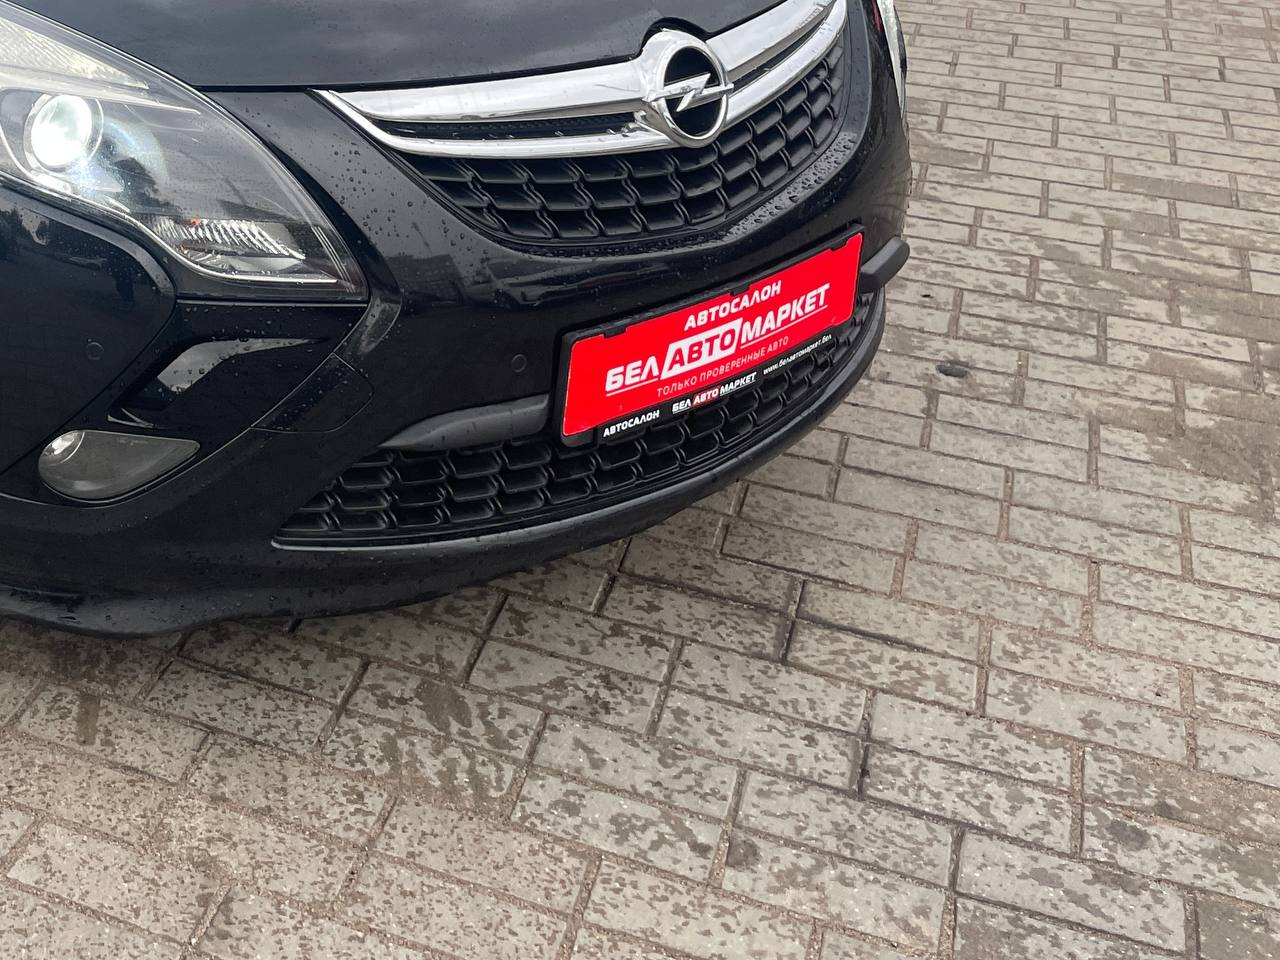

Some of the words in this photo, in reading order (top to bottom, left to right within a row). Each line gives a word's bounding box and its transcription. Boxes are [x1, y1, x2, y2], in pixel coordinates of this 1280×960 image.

[684, 280, 782, 331] АВТОСАЛОН
[657, 375, 698, 397] ТОЛЬКО
[700, 347, 766, 382] ПРОВЕРЕННЫЕ
[767, 336, 789, 355] АВТО
[603, 409, 660, 437] АВТОСАЛОН
[672, 398, 692, 413] БЕЛ
[693, 387, 719, 405] АВТО
[720, 372, 757, 394] МАРКЕТ
